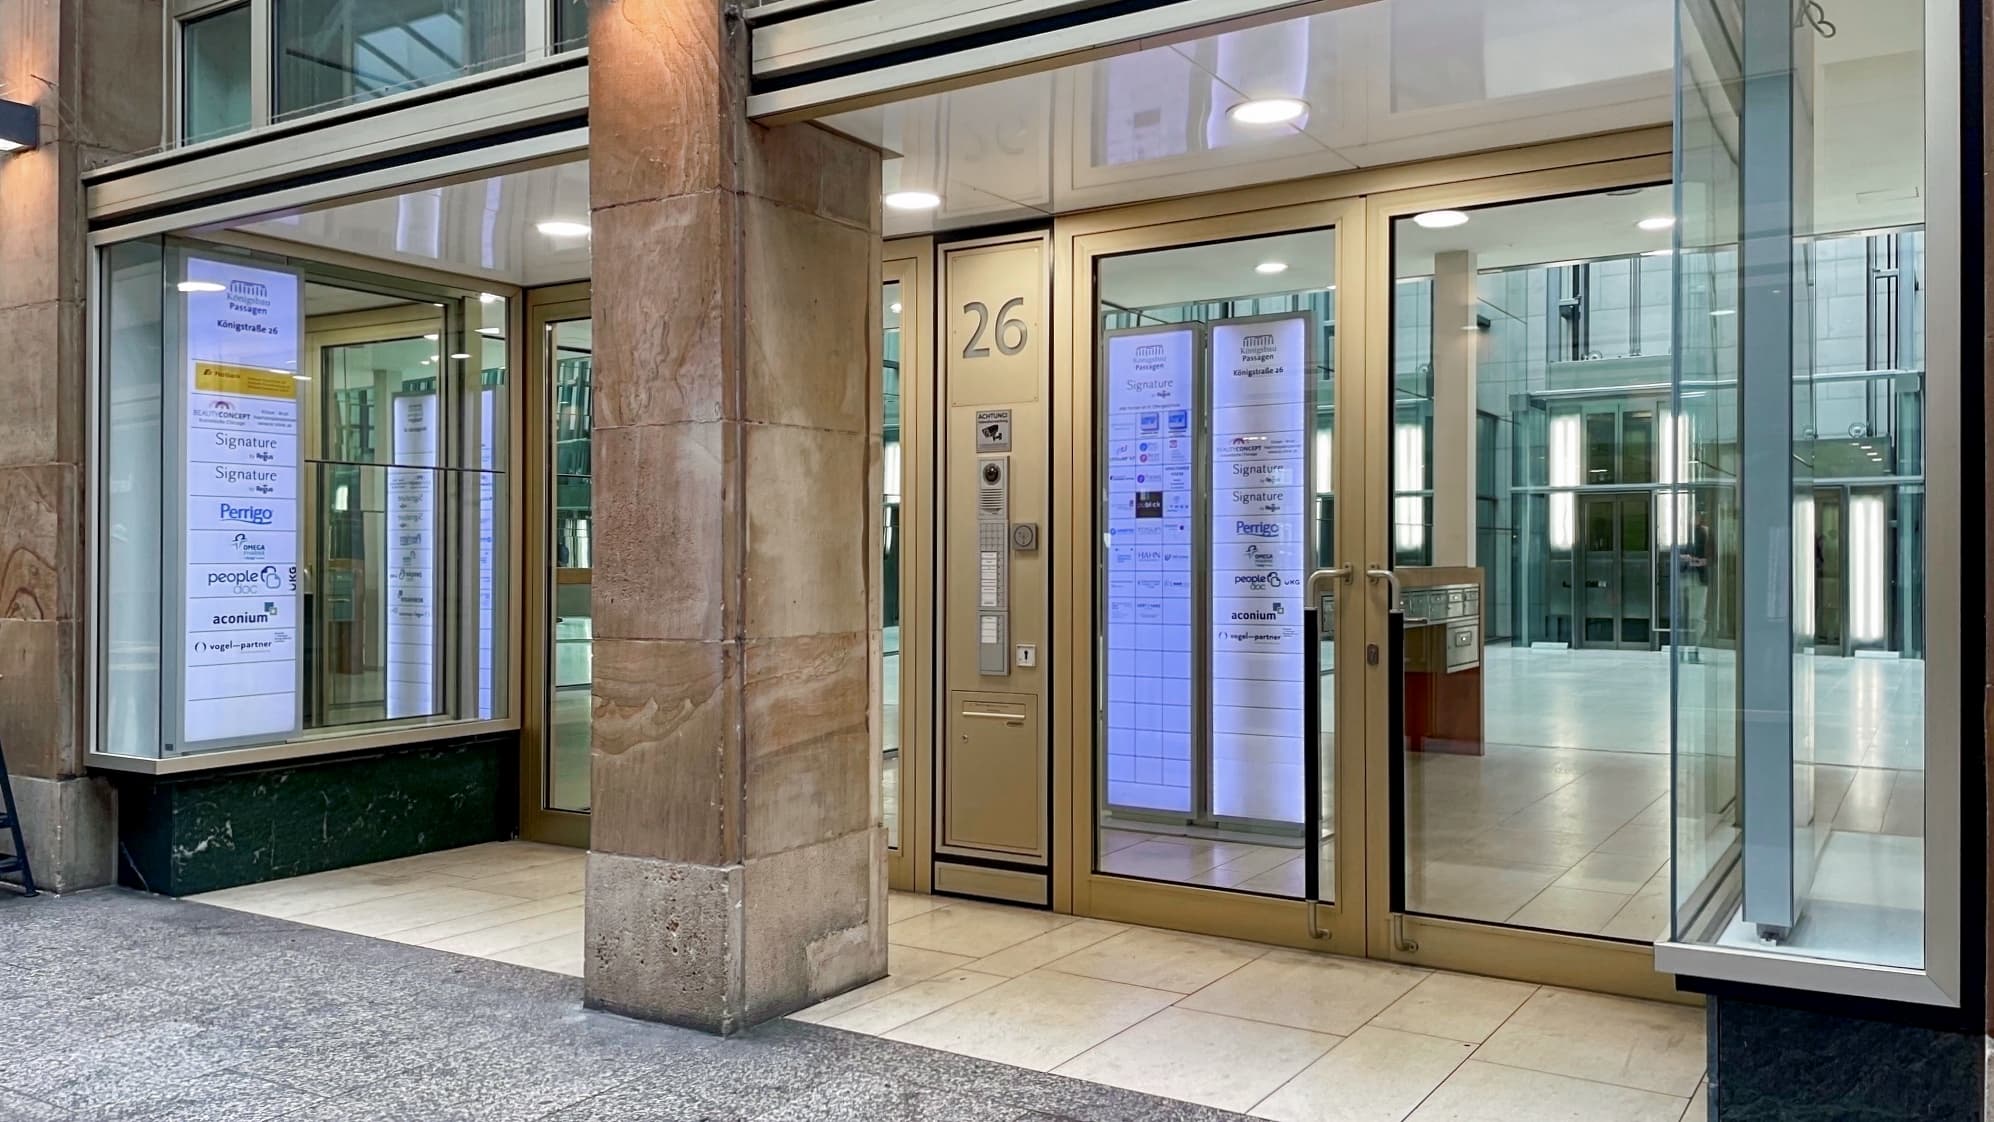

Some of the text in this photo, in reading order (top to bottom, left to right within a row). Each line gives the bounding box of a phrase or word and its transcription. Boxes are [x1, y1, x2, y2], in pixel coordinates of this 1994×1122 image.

[229, 302, 268, 316] Passagen
[217, 319, 279, 335] Königstraße 26
[963, 297, 1028, 359] 26
[1242, 354, 1274, 362] Passagen
[1233, 367, 1274, 377] Königstraße
[1126, 379, 1174, 392] Signature
[215, 432, 278, 450] Signature
[215, 465, 278, 483] Signature
[1233, 463, 1284, 477] Signature
[1233, 490, 1284, 504] Signature
[220, 503, 273, 524] Perrigo
[1236, 521, 1280, 537] Perrigo
[208, 570, 259, 586] people
[1234, 574, 1266, 585] people
[233, 585, 258, 595] doc
[212, 611, 268, 625] aconium
[1231, 609, 1277, 620] aconium
